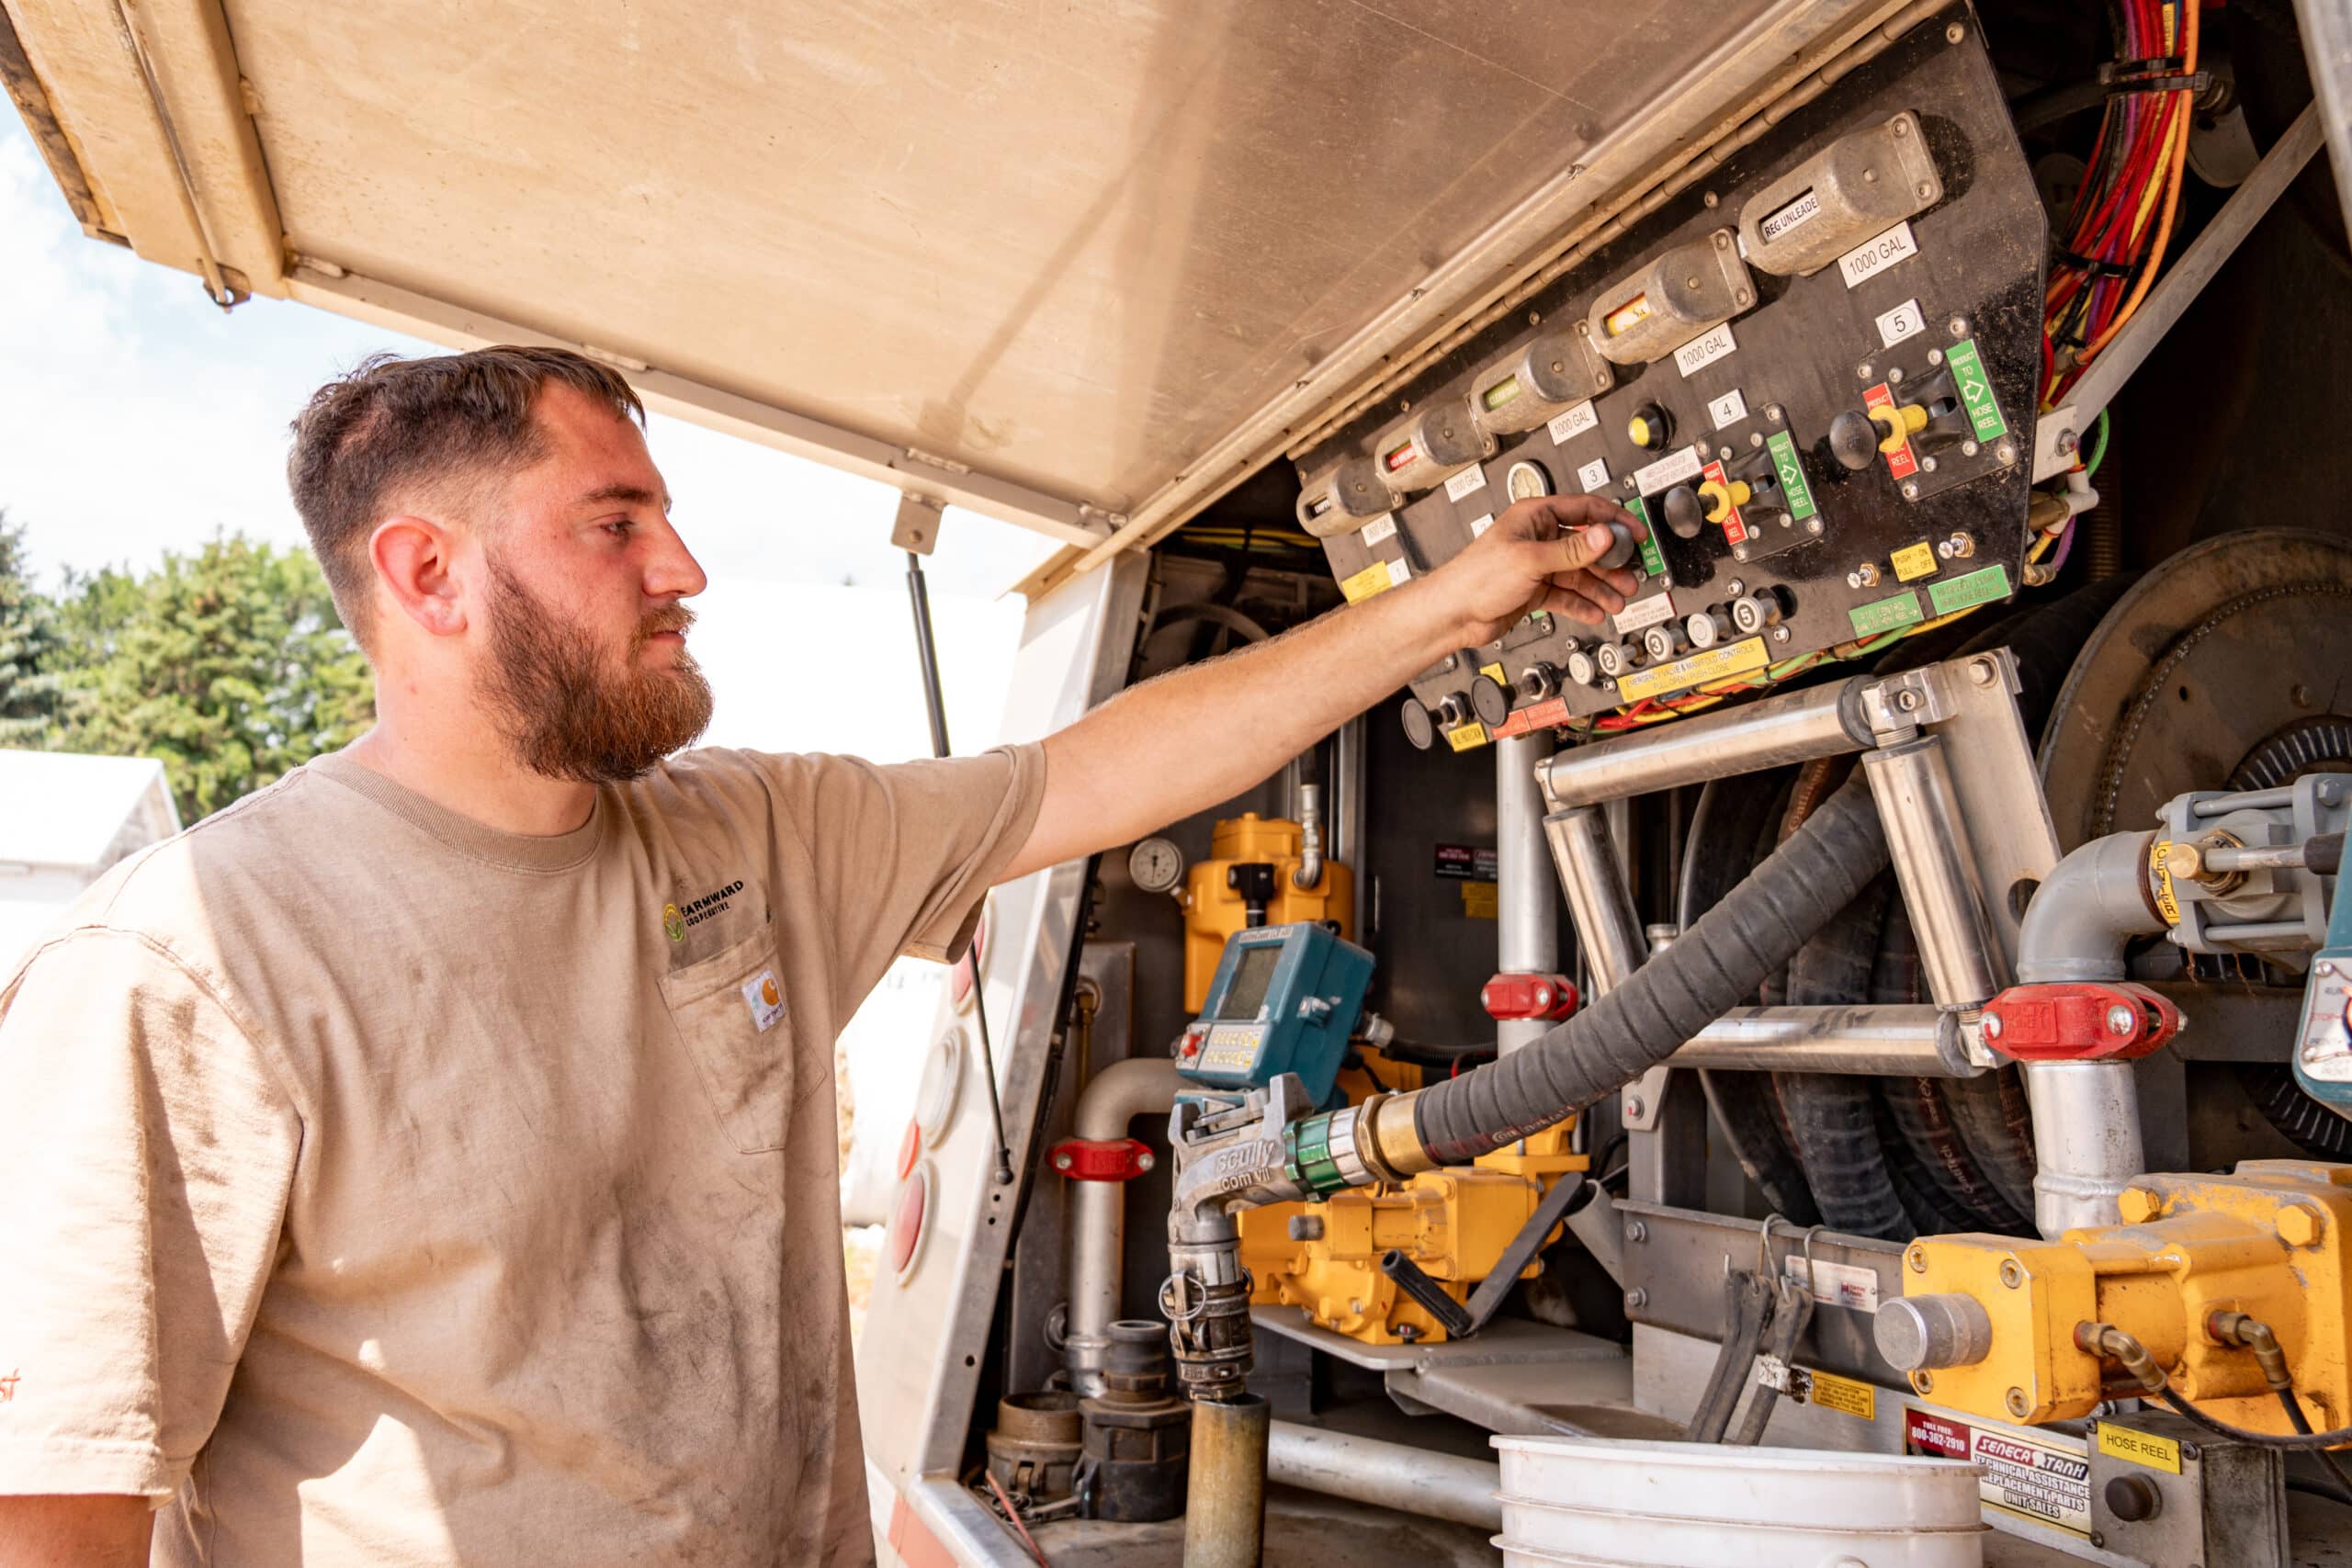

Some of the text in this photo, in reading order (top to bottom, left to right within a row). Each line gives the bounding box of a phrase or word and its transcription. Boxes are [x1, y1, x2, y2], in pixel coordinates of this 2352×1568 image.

[1764, 222, 1781, 237] REG
[1849, 235, 1907, 276] 1000 GAL
[1894, 314, 1906, 333] 5
[1683, 335, 1728, 367] 1000 GAL
[1951, 351, 1975, 367] PRODUCT
[1962, 366, 1973, 377] TO
[1867, 394, 1890, 408] PRODUCT
[1723, 402, 1732, 417] 4
[1972, 402, 1993, 418] HOSE
[1572, 411, 1591, 427] GAL
[1976, 416, 1997, 430] REEL
[1780, 453, 1789, 462] TO
[1891, 454, 1910, 467] REEL
[1589, 469, 1598, 483] 3
[1792, 497, 1809, 508] REEL
[1894, 553, 1912, 565] PUSH
[1918, 548, 1928, 558] ON
[1897, 566, 1914, 577] PULL
[1920, 559, 1933, 570] OFF
[1740, 608, 1751, 624] 5
[1653, 637, 1660, 650] 3
[1605, 655, 1614, 667] 2
[1626, 670, 1661, 686] EMERGENCY
[1686, 655, 1718, 671] MANIFOLD
[1718, 644, 1756, 661] CONTROLS
[1670, 675, 1687, 686] OPEN
[1690, 670, 1709, 682] PUSH
[1708, 663, 1729, 677] CLOSE
[1218, 1140, 1274, 1171] scully
[1221, 1172, 1253, 1191] com
[1923, 1421, 1938, 1431] TOLL
[1912, 1426, 1965, 1452] 800-362-2910
[2107, 1434, 2172, 1461] HOSE REEL
[1979, 1438, 2086, 1479] SENECA TANK
[1975, 1454, 2090, 1498] TECHNICAL ASSISTANCE
[2004, 1489, 2061, 1518] UNIT SALES
[2051, 1495, 2085, 1512] PARTS
